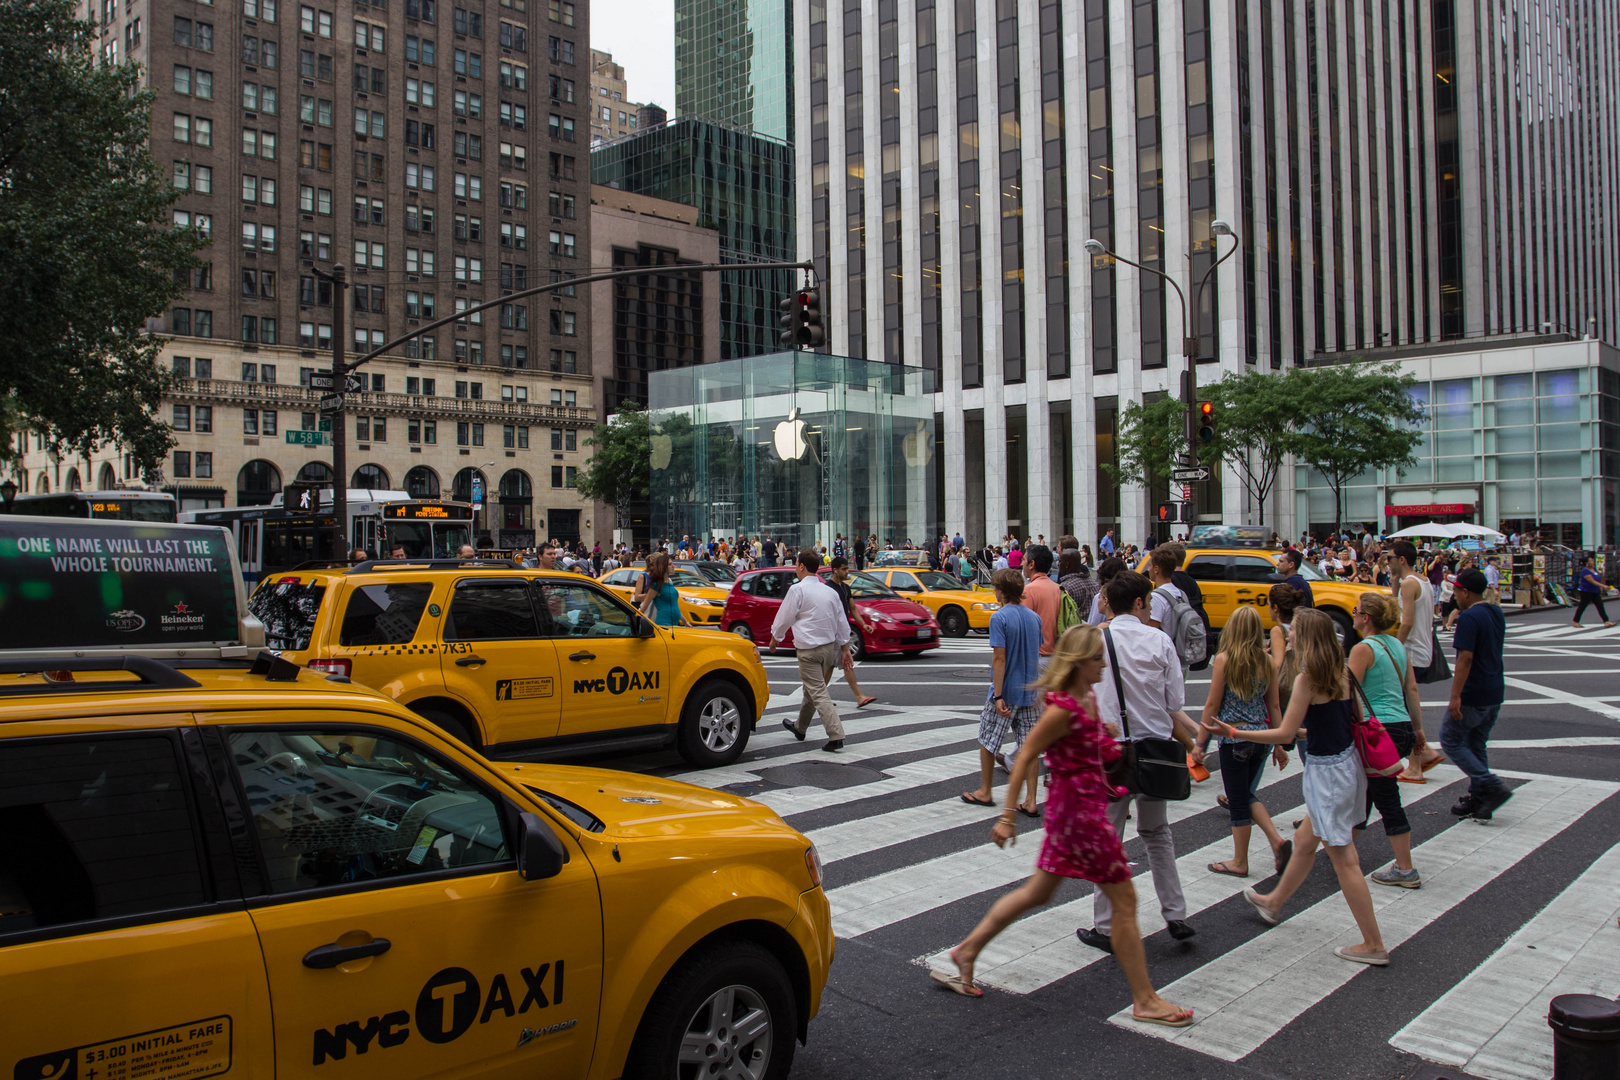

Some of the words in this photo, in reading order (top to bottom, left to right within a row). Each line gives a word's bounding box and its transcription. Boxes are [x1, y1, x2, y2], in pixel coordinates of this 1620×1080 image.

[316, 378, 331, 386] ONE
[288, 431, 296, 442] W
[300, 432, 313, 443] 58
[17, 537, 51, 553] ONE
[55, 537, 102, 553] NAME
[105, 538, 144, 554] WILL
[146, 539, 179, 554] LAST
[183, 540, 211, 554] THE
[50, 556, 108, 572] WHOLE
[111, 557, 218, 572] TOURNAMENT.
[105, 619, 116, 627] US
[117, 618, 140, 626] OPEN
[160, 614, 204, 624] Heineken
[441, 643, 473, 655] 7K31
[573, 679, 605, 693] NYC
[611, 671, 660, 691] TAXI
[312, 1009, 410, 1066] NYC
[431, 959, 565, 1034] TAXI
[534, 1018, 578, 1037] HYBRID
[85, 1045, 126, 1064] $3.00
[131, 1033, 183, 1053] INITIAL
[189, 1023, 223, 1040] FARE
[131, 1056, 144, 1064] PER
[176, 1044, 199, 1053] MINUTE
[167, 1067, 204, 1079] MANHATTAN
